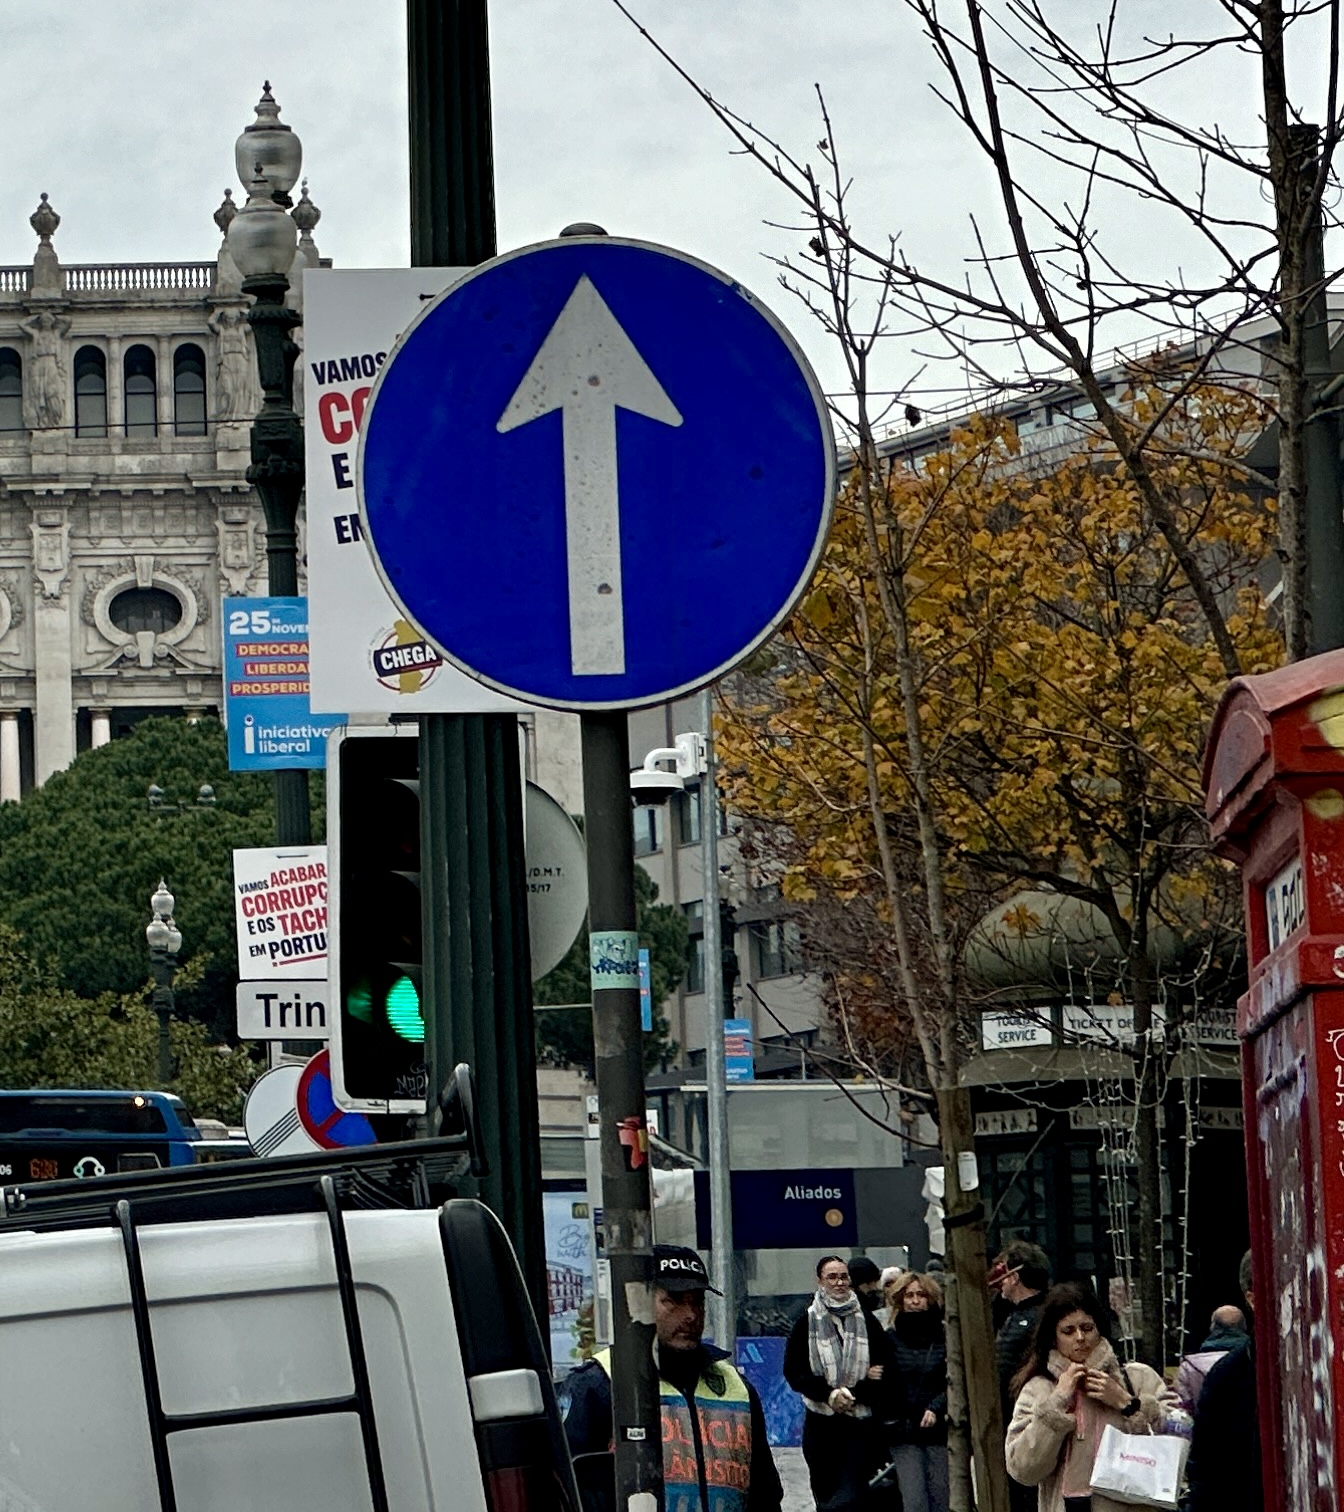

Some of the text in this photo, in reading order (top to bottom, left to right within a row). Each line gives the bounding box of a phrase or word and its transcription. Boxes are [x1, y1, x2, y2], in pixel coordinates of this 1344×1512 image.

[331, 452, 354, 490] E
[229, 611, 271, 635] 25
[380, 644, 438, 671] CHEGA
[258, 739, 310, 753] liberal
[238, 863, 327, 894] VAMOS ACABAR
[247, 920, 257, 935] E
[257, 917, 276, 933] OS
[249, 932, 327, 960] EM PORTU
[255, 993, 326, 1028] Trin
[997, 1029, 1037, 1044] SERVICE
[784, 1185, 842, 1200] Aliados
